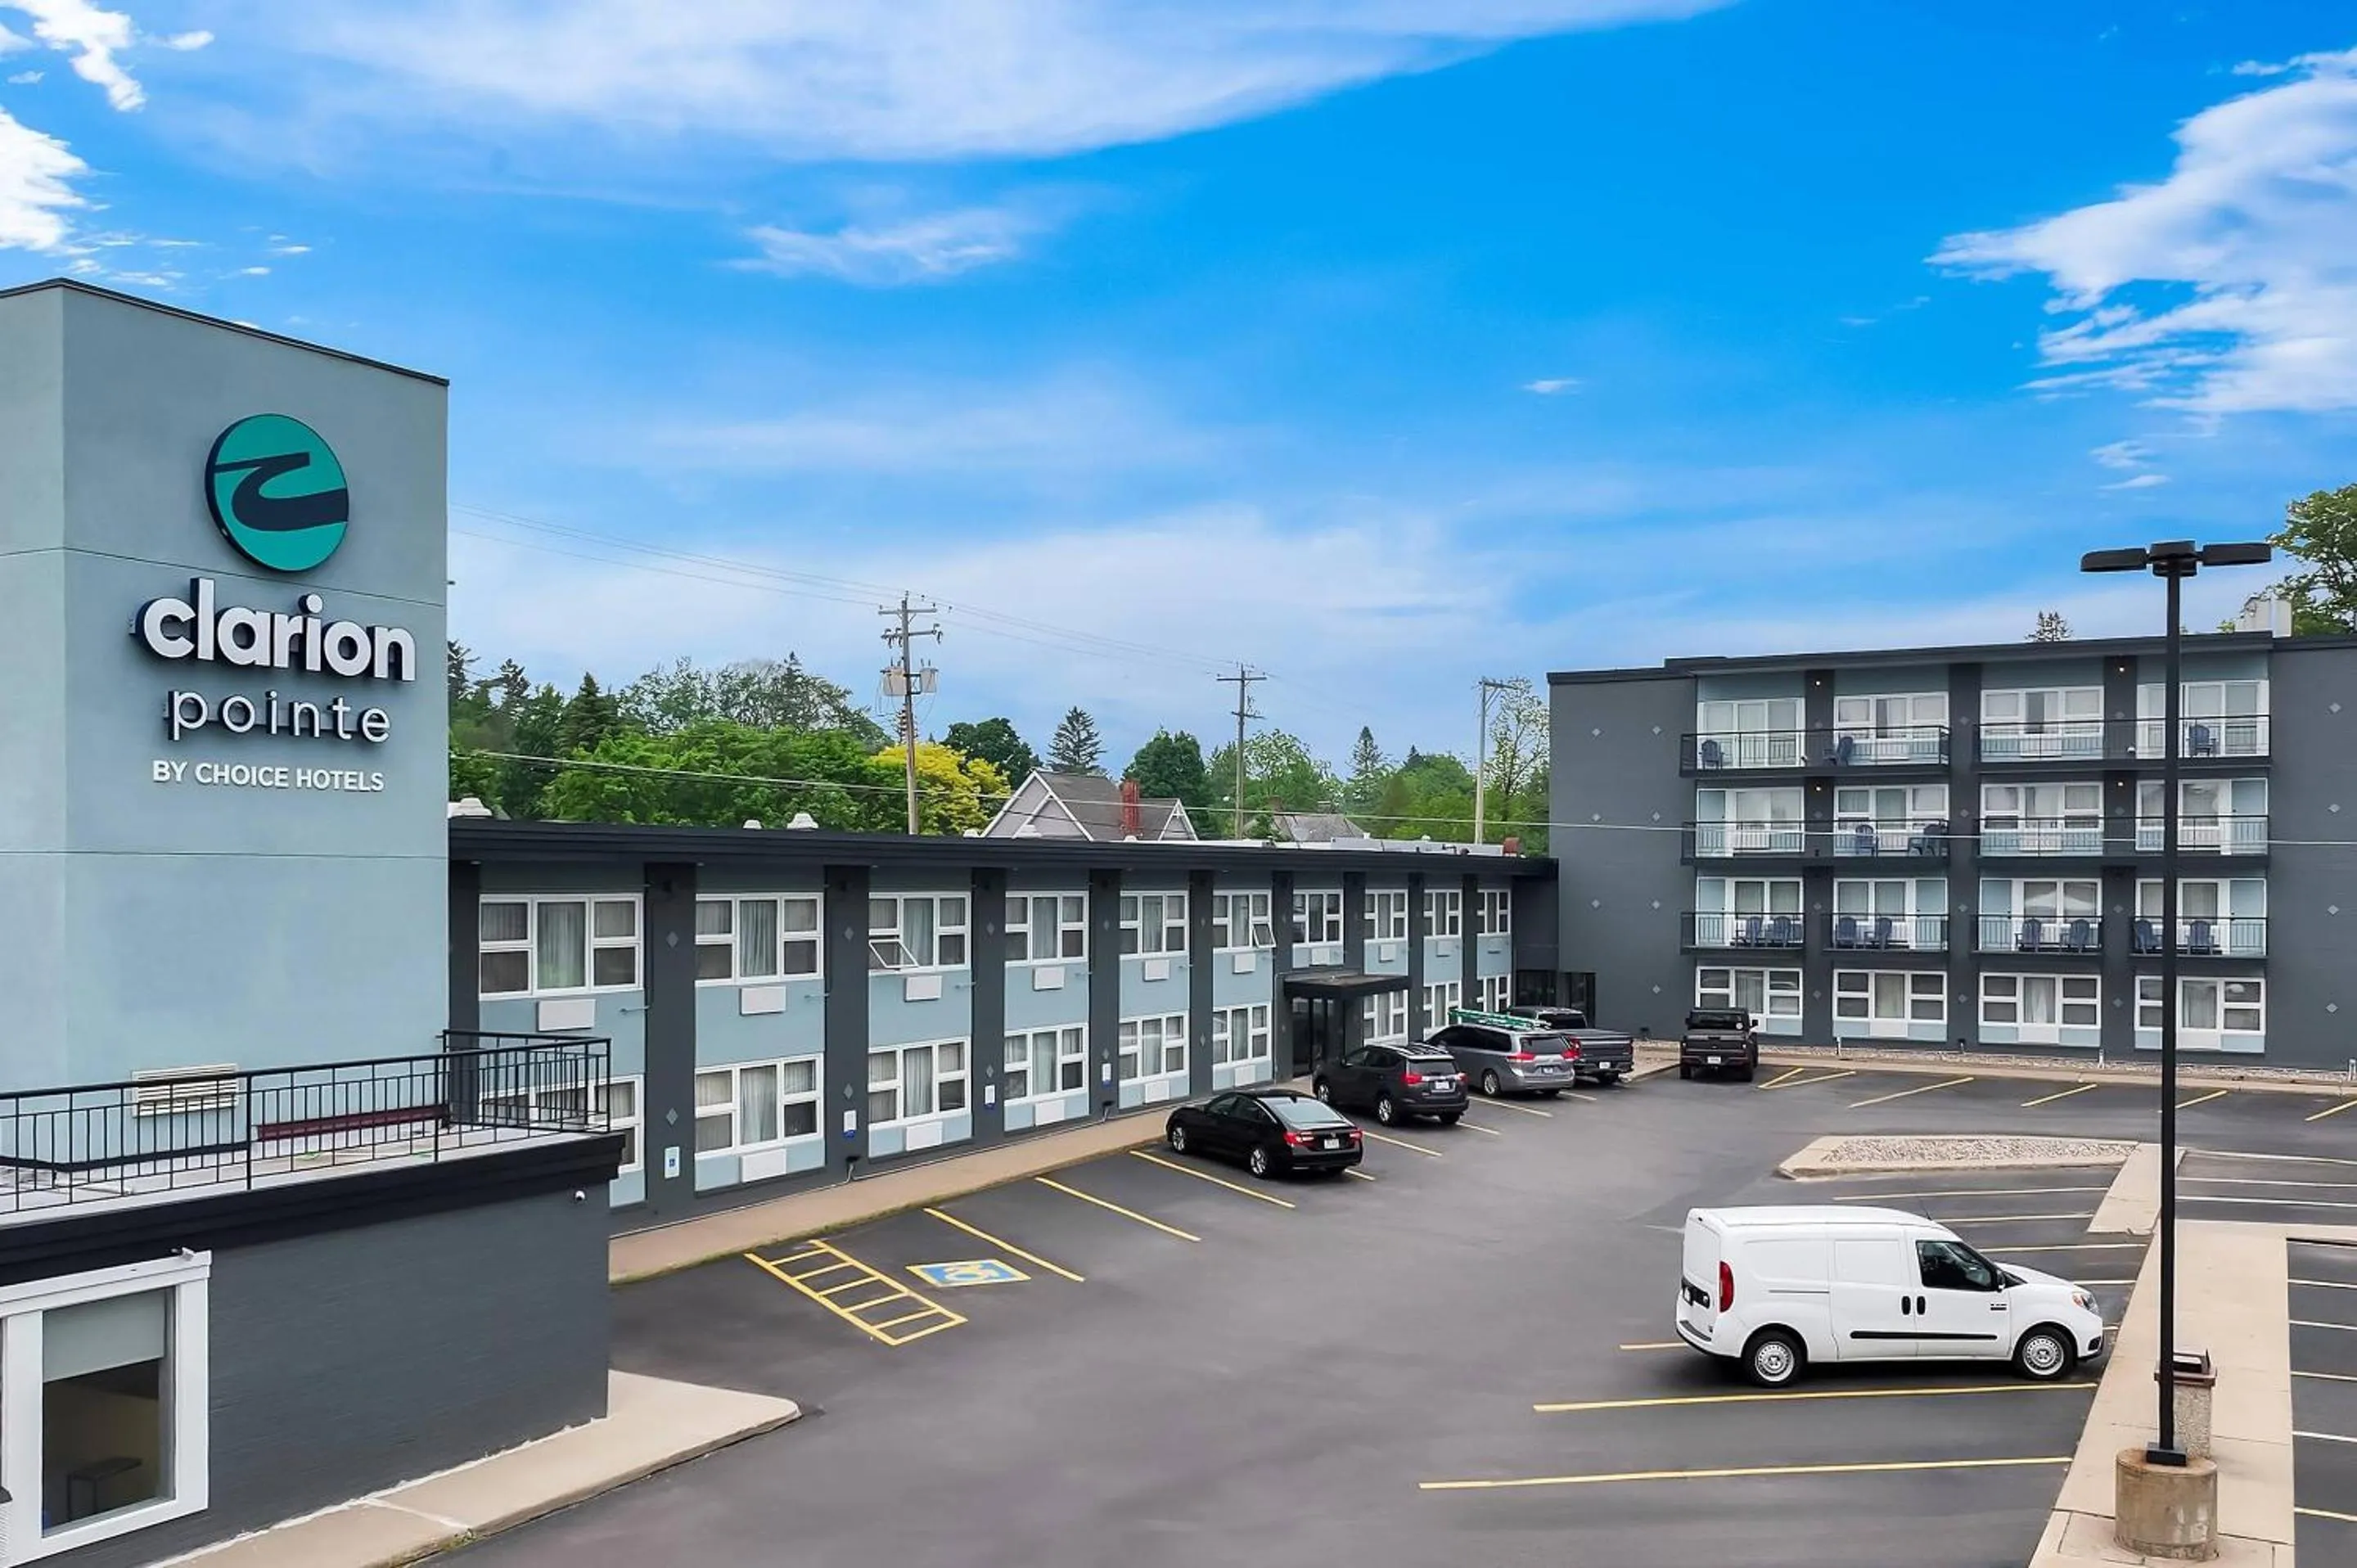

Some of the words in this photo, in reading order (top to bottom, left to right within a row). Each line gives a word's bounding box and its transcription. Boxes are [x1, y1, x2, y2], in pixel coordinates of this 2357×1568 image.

[137, 577, 417, 682] clarion
[169, 690, 391, 743] pointe
[152, 759, 188, 782] BY
[195, 763, 290, 787] CHOICE
[296, 768, 385, 792] HOTELS
